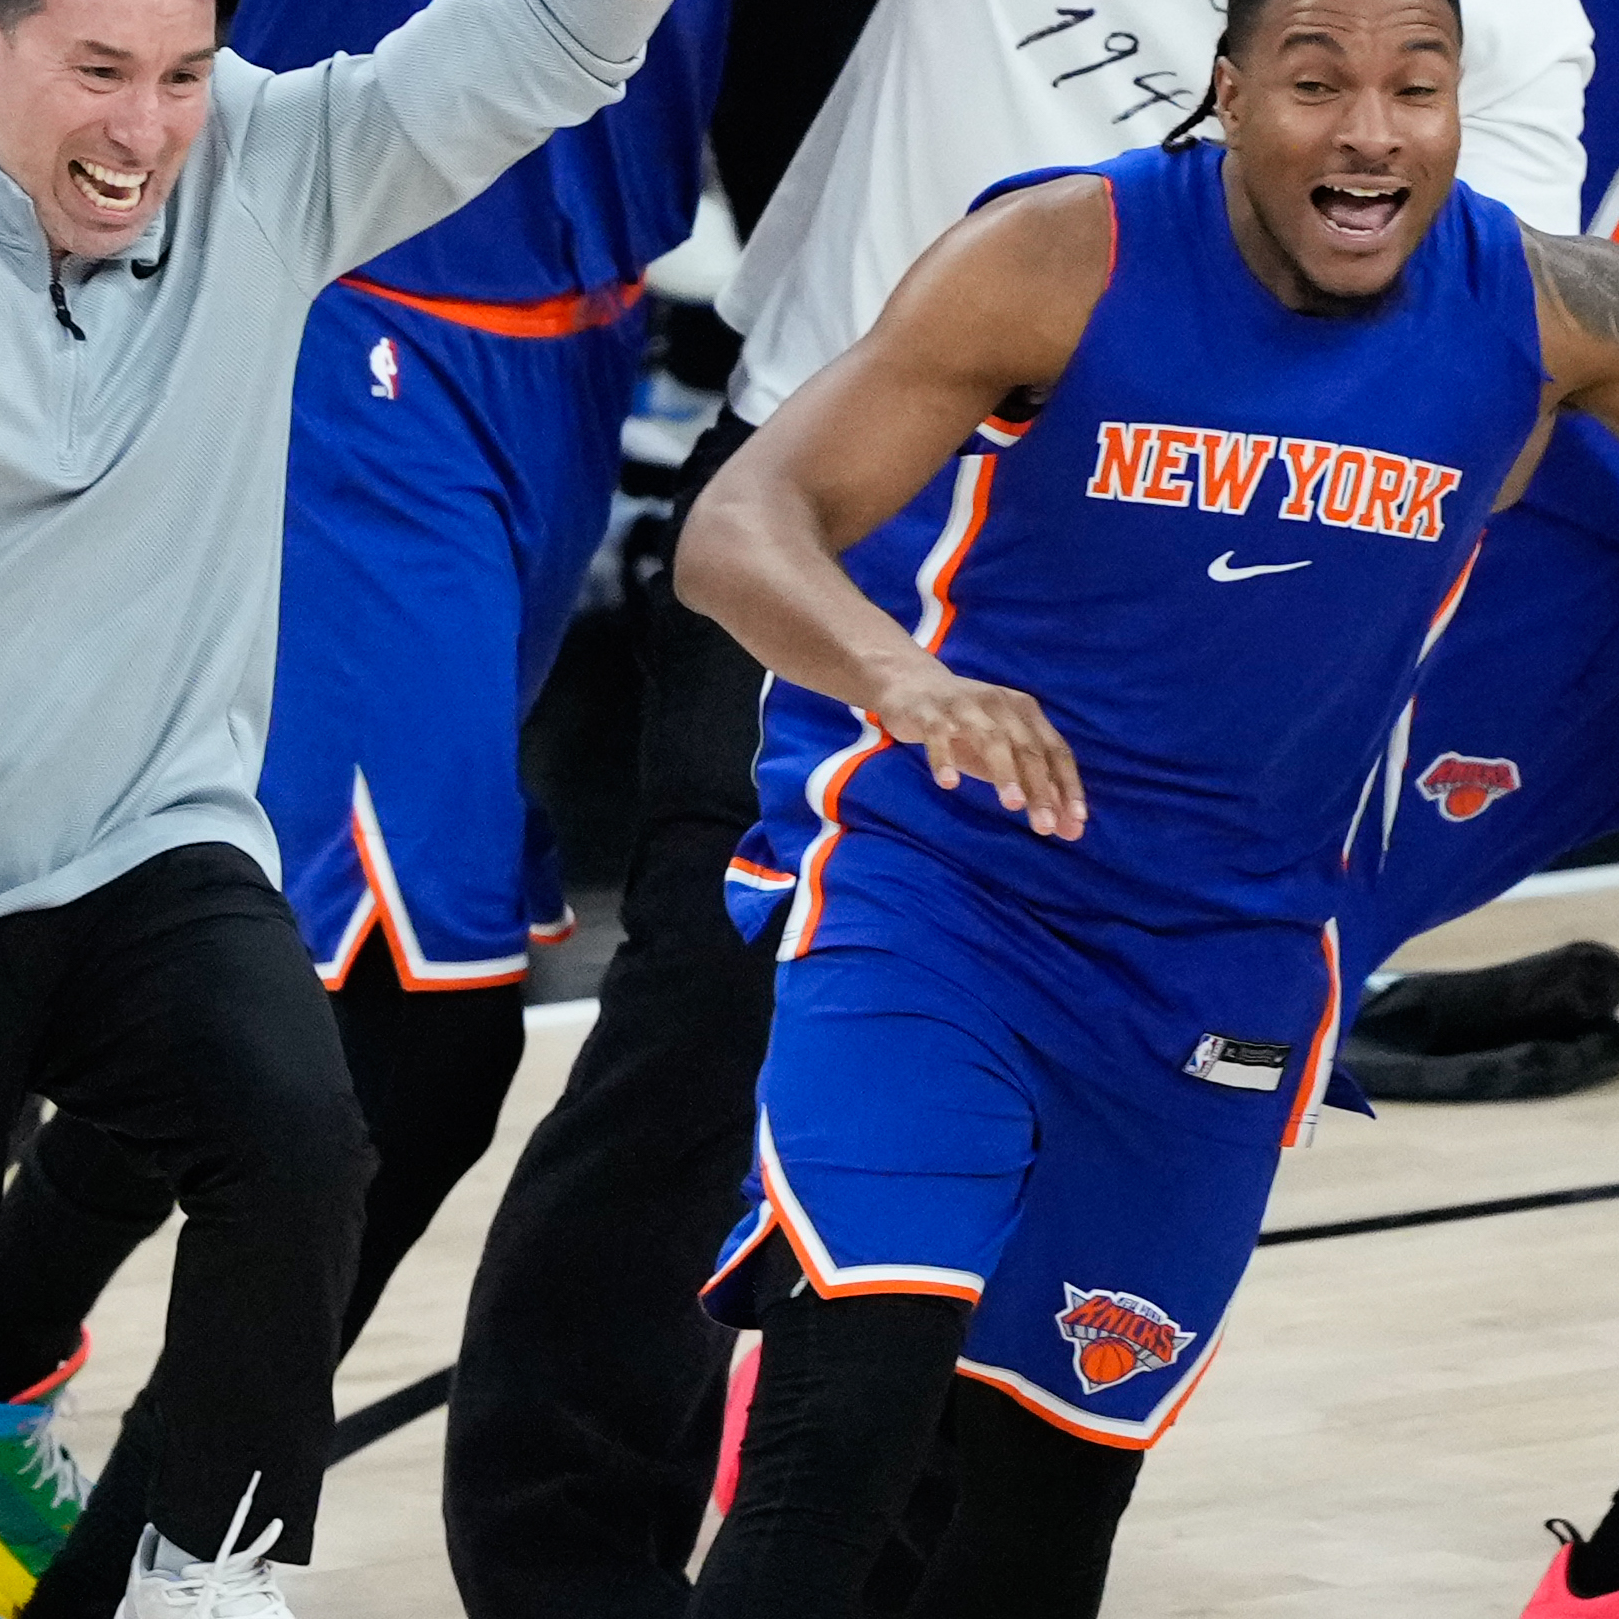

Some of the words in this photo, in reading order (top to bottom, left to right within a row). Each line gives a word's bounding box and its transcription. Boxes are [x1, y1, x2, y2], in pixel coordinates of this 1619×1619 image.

[1015, 7, 1196, 125] 194
[1085, 421, 1279, 517] NEW
[1277, 436, 1464, 543] YORK
[1061, 1295, 1176, 1364] KNICKS
